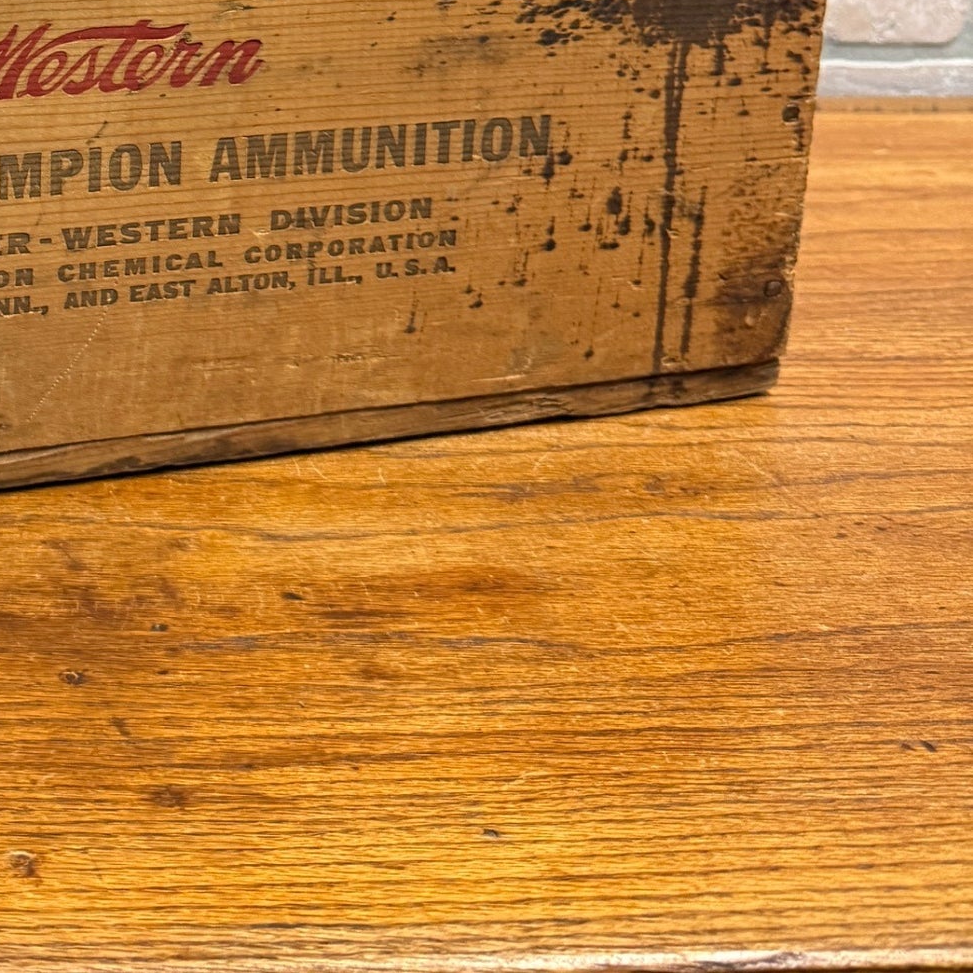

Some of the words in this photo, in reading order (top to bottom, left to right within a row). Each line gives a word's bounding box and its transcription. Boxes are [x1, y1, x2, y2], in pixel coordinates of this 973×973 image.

[210, 114, 552, 183] AMMUNITION
[270, 197, 432, 232] DIVISION
[56, 250, 224, 283] CHEMICAL
[244, 229, 457, 264] CORPORATION
[63, 288, 119, 310] AND
[129, 278, 197, 303] EAST
[206, 270, 296, 295] ALTON,
